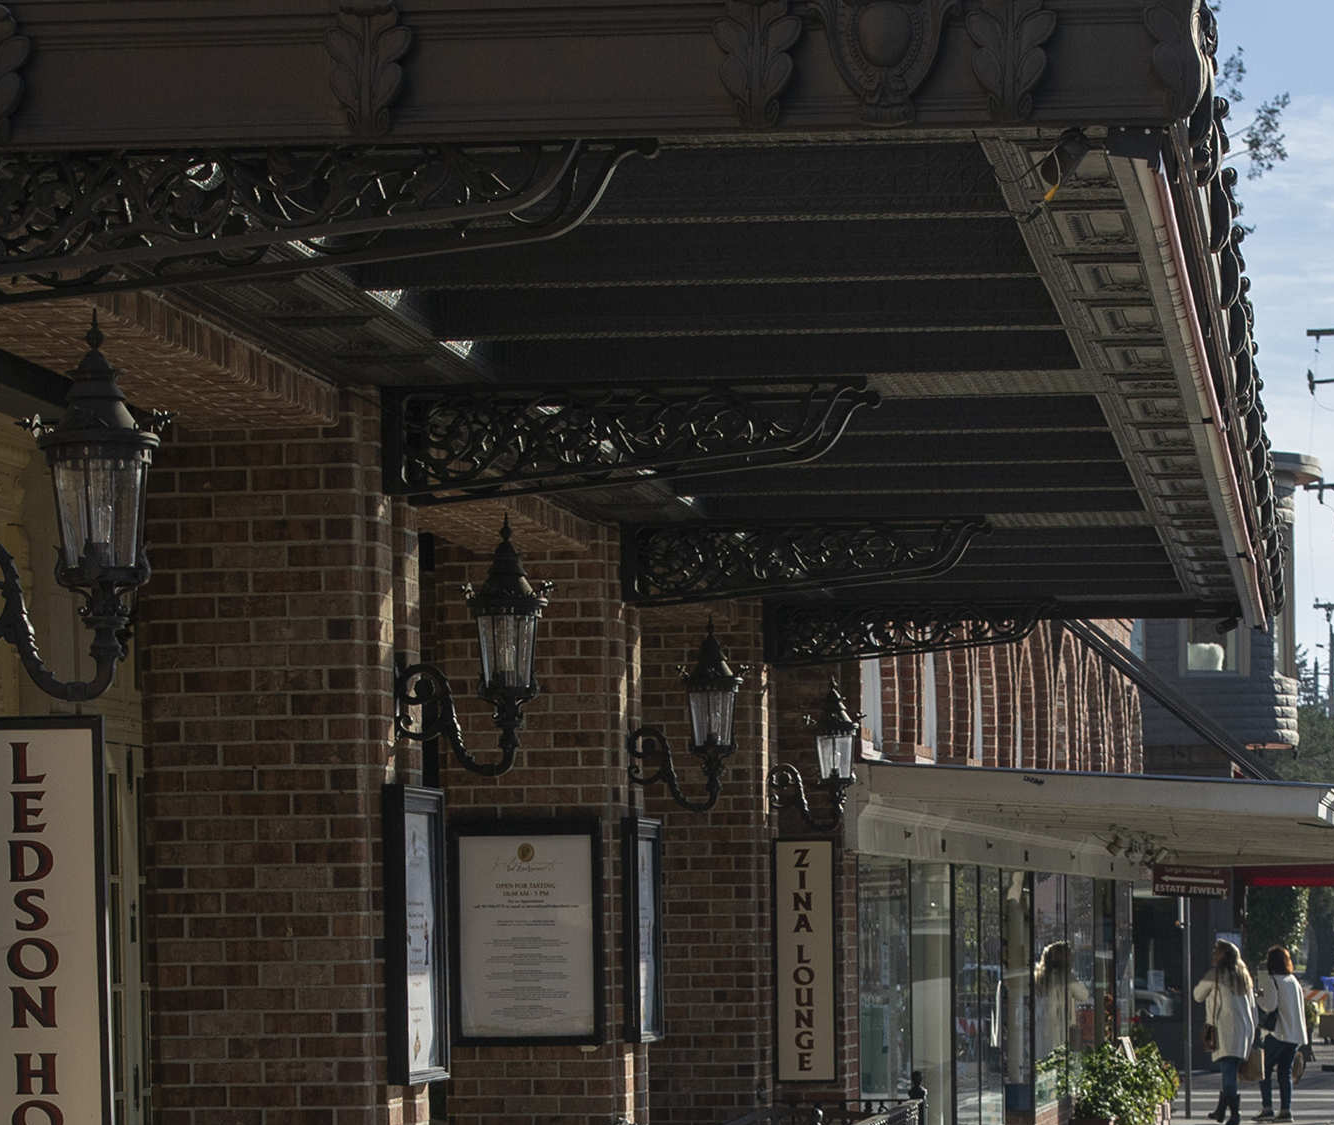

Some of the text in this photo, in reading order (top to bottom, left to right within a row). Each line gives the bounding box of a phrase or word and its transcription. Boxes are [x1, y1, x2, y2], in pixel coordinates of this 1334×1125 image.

[6, 742, 59, 1028] LEDSON
[792, 849, 815, 1072] ZINA LOUNGE
[1155, 884, 1228, 896] ESTATE JEWELRY
